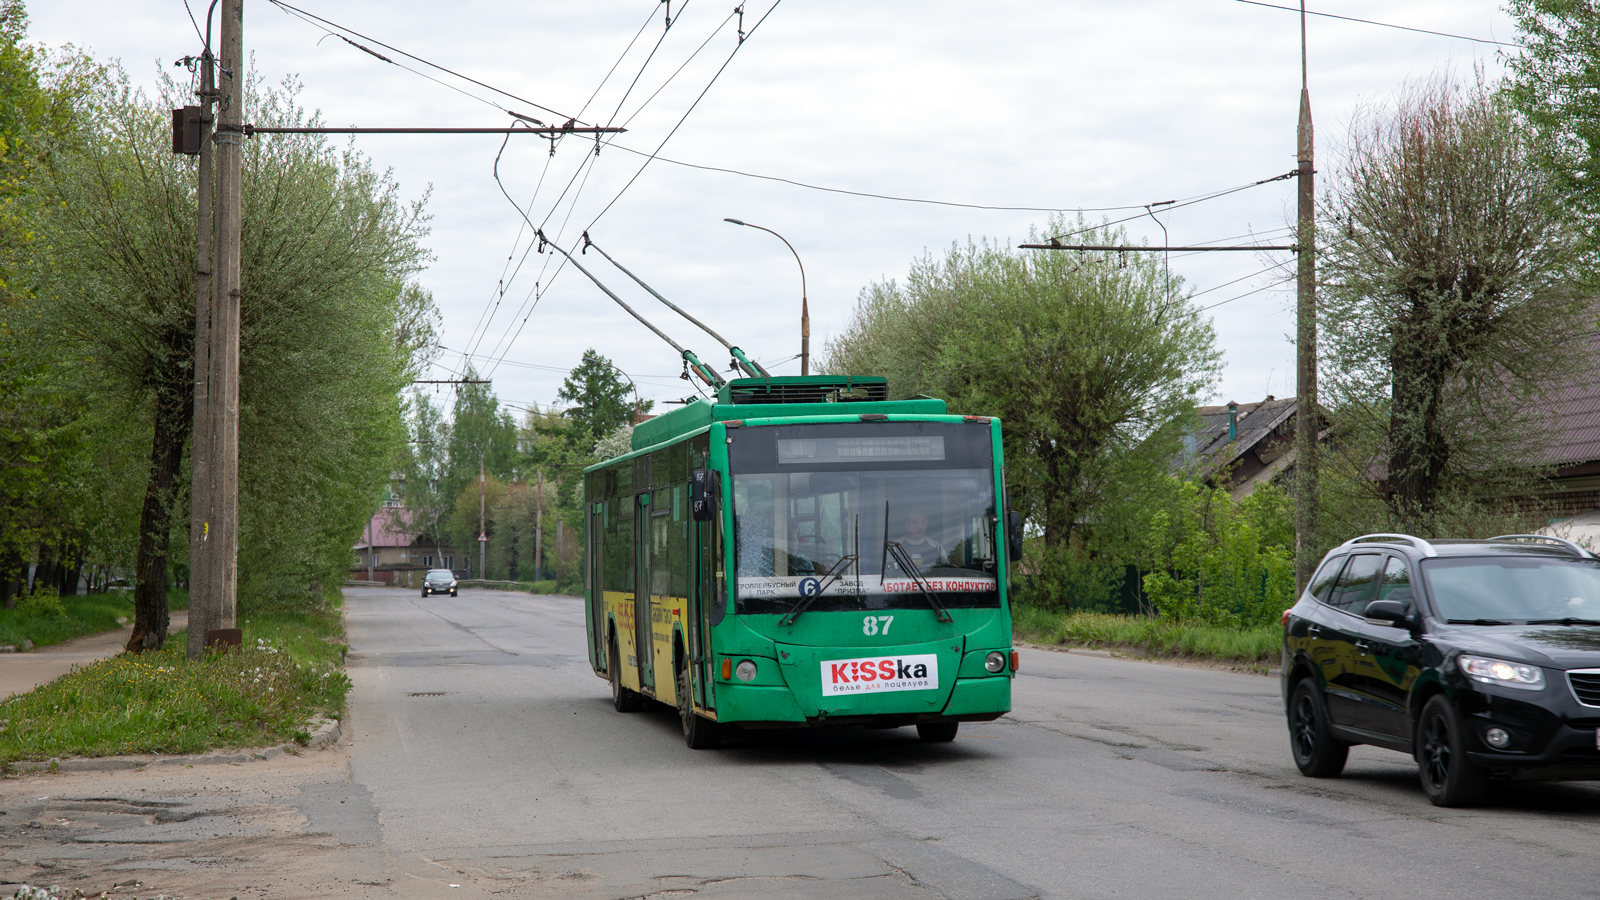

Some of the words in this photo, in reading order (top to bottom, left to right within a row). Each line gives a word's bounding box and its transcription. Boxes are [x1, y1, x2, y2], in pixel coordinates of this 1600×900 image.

[693, 500, 703, 512] 87
[804, 580, 816, 596] 6
[925, 581, 944, 591] БЕЗ
[862, 615, 895, 636] 87
[833, 684, 861, 692] белье
[865, 683, 881, 691] для
[884, 680, 929, 689] поцелуев
